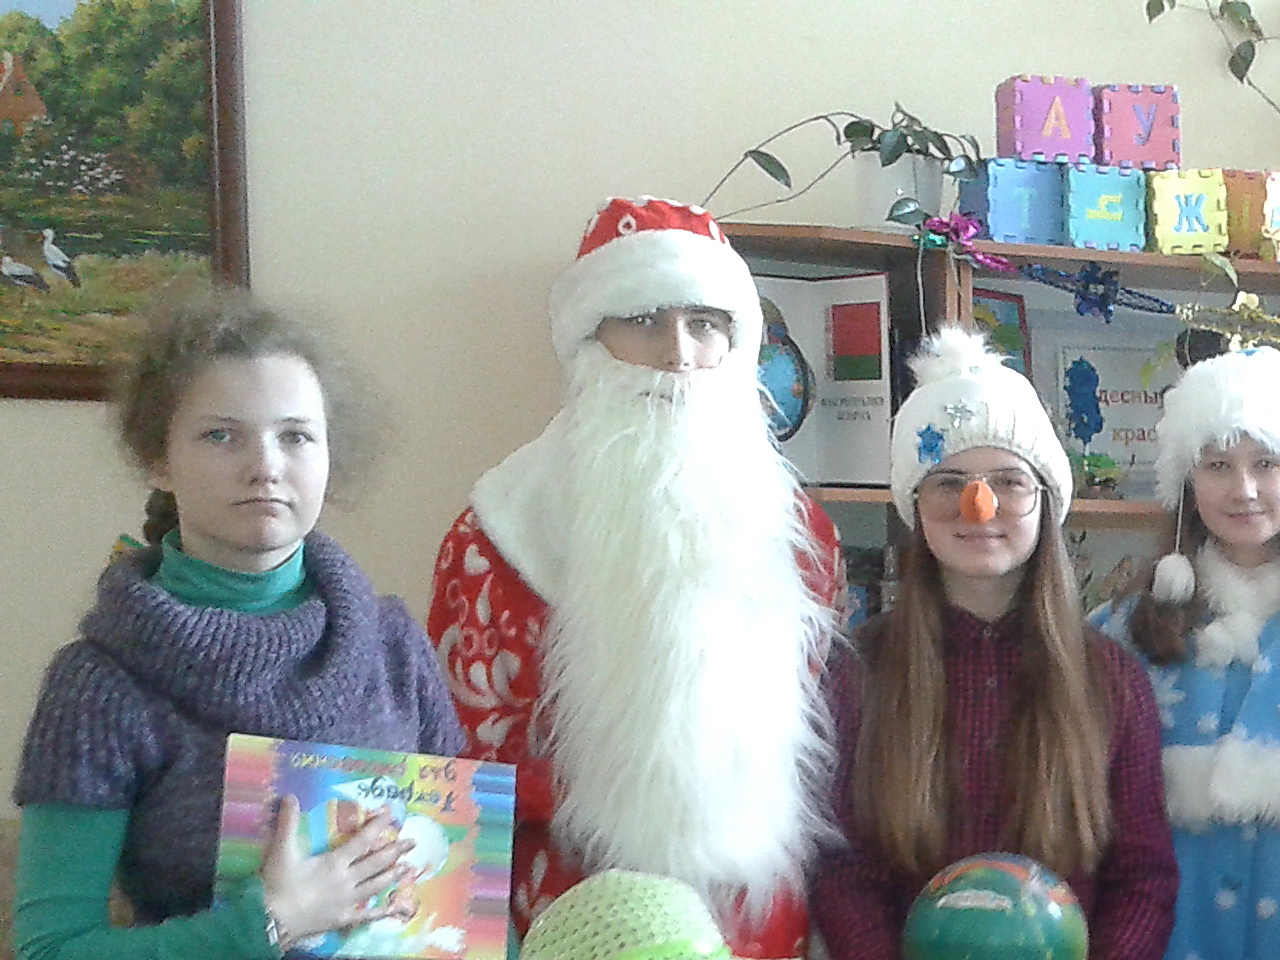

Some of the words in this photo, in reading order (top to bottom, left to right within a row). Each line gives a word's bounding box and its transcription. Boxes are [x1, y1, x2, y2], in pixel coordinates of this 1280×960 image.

[1041, 95, 1072, 139] А
[1173, 193, 1209, 233] Ж
[1112, 427, 1158, 447] крас
